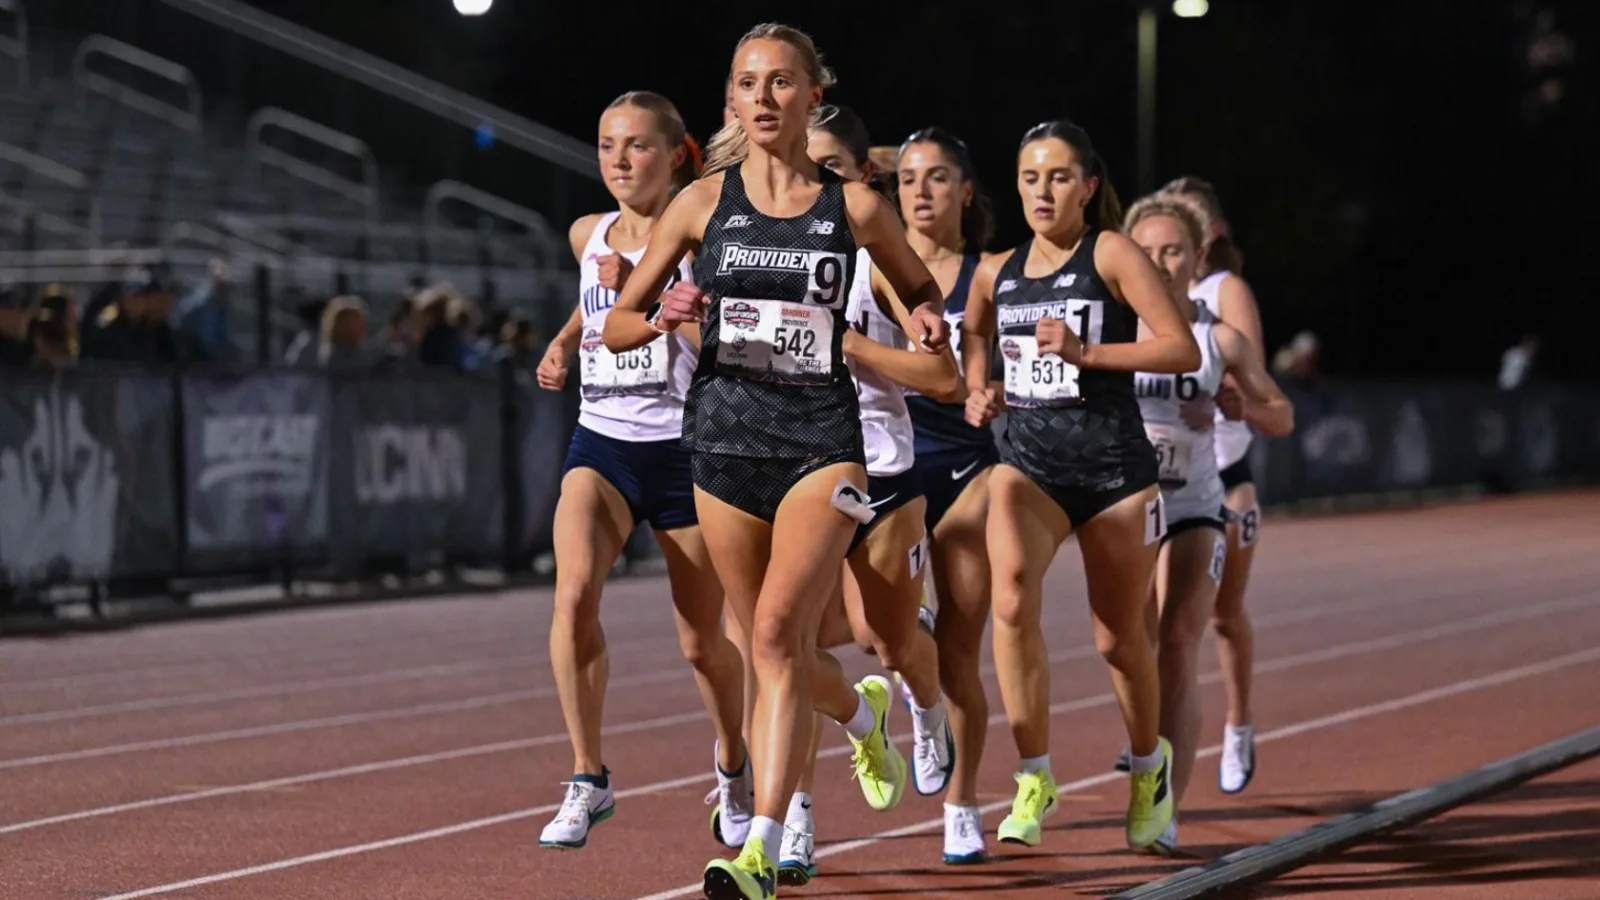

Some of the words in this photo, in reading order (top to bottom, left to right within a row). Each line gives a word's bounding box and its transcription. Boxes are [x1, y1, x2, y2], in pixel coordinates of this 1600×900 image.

[723, 220, 753, 228] EAST
[812, 256, 842, 304] 9
[584, 284, 619, 318] VILL
[1073, 304, 1091, 345] 1
[772, 327, 816, 358] 542
[1031, 360, 1064, 384] 531
[1175, 373, 1198, 401] 6
[1149, 501, 1161, 538] 1
[1242, 510, 1257, 542] 8
[911, 543, 922, 569] 1
